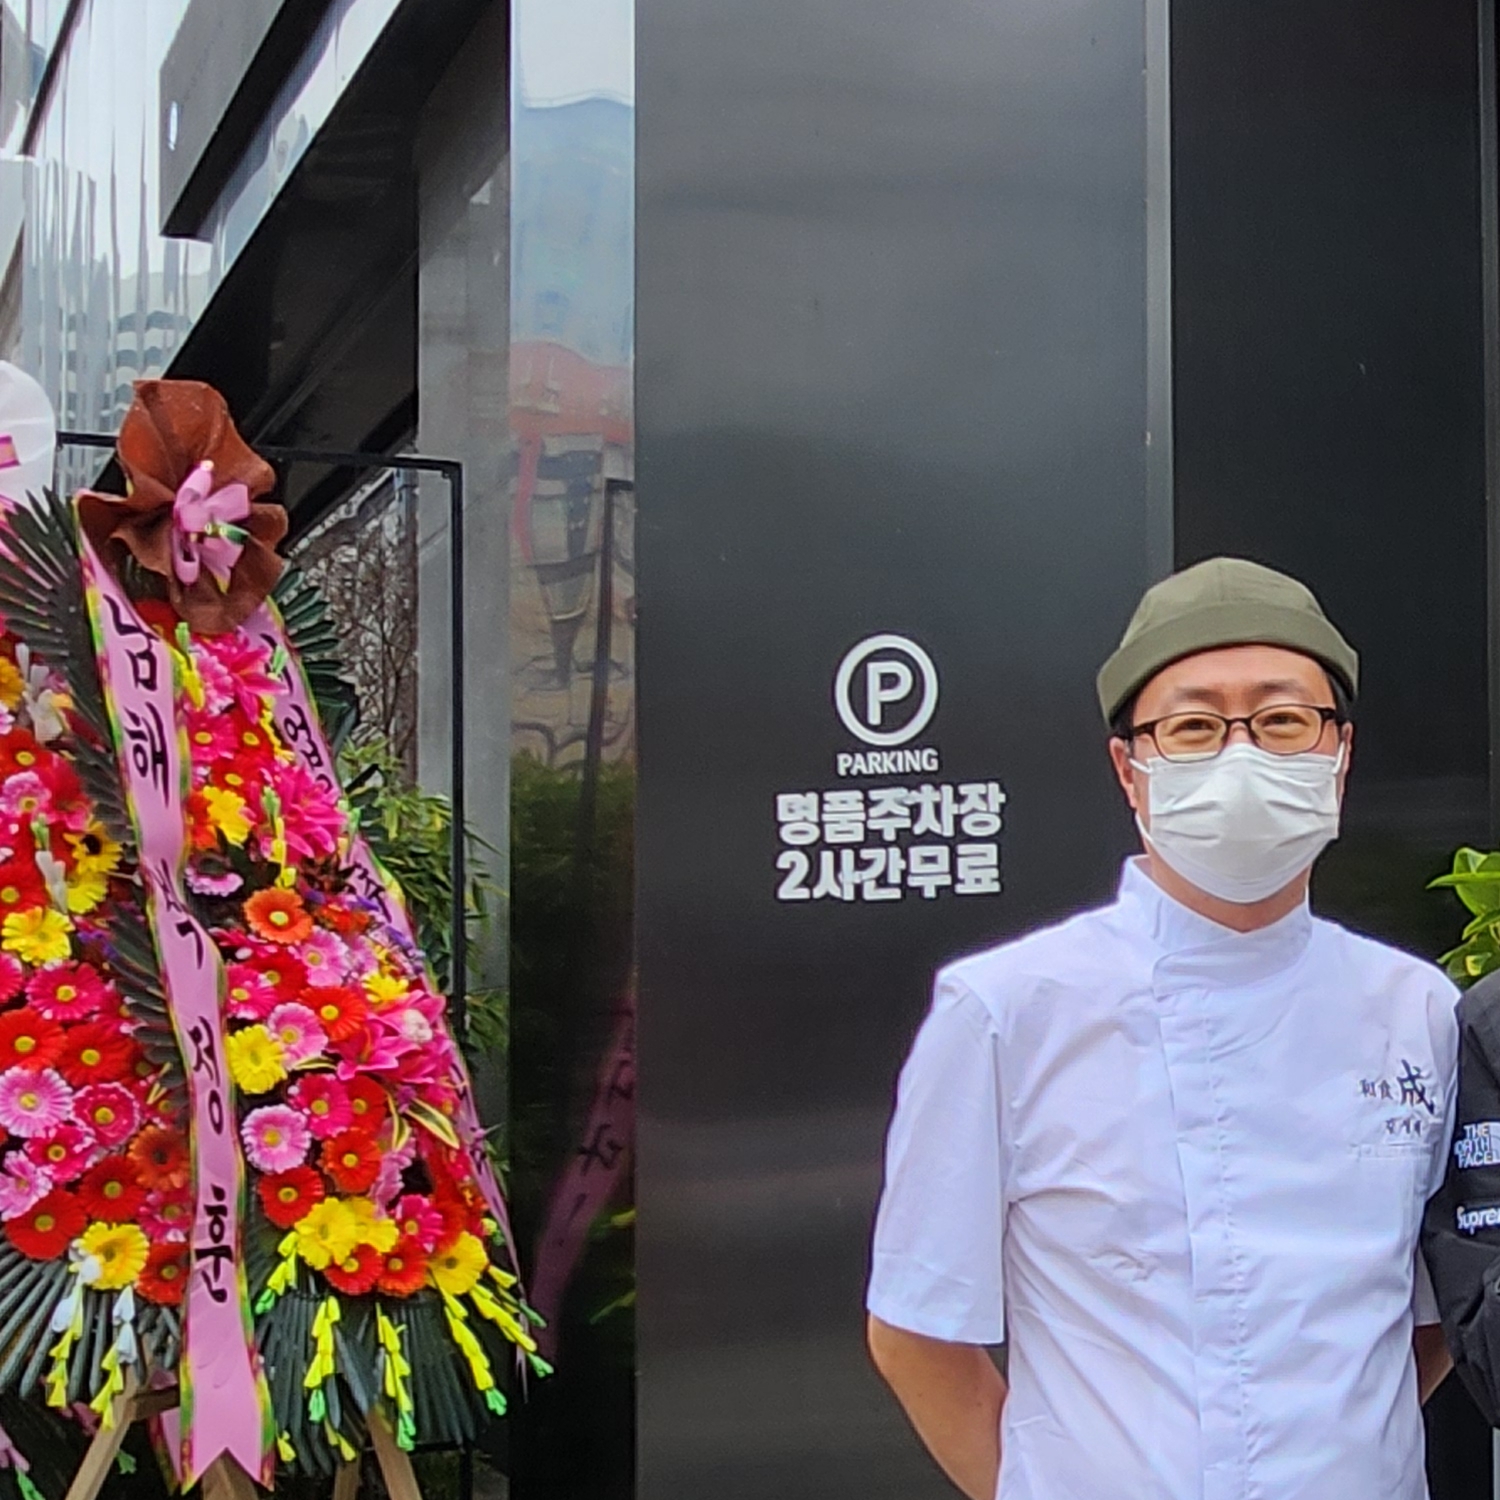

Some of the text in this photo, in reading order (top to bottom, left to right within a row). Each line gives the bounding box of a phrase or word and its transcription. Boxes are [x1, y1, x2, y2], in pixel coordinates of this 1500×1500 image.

[102, 594, 170, 808] 남해
[837, 749, 939, 776] PARKING
[776, 782, 1006, 845] 명품주차장
[1463, 1122, 1490, 1140] THE
